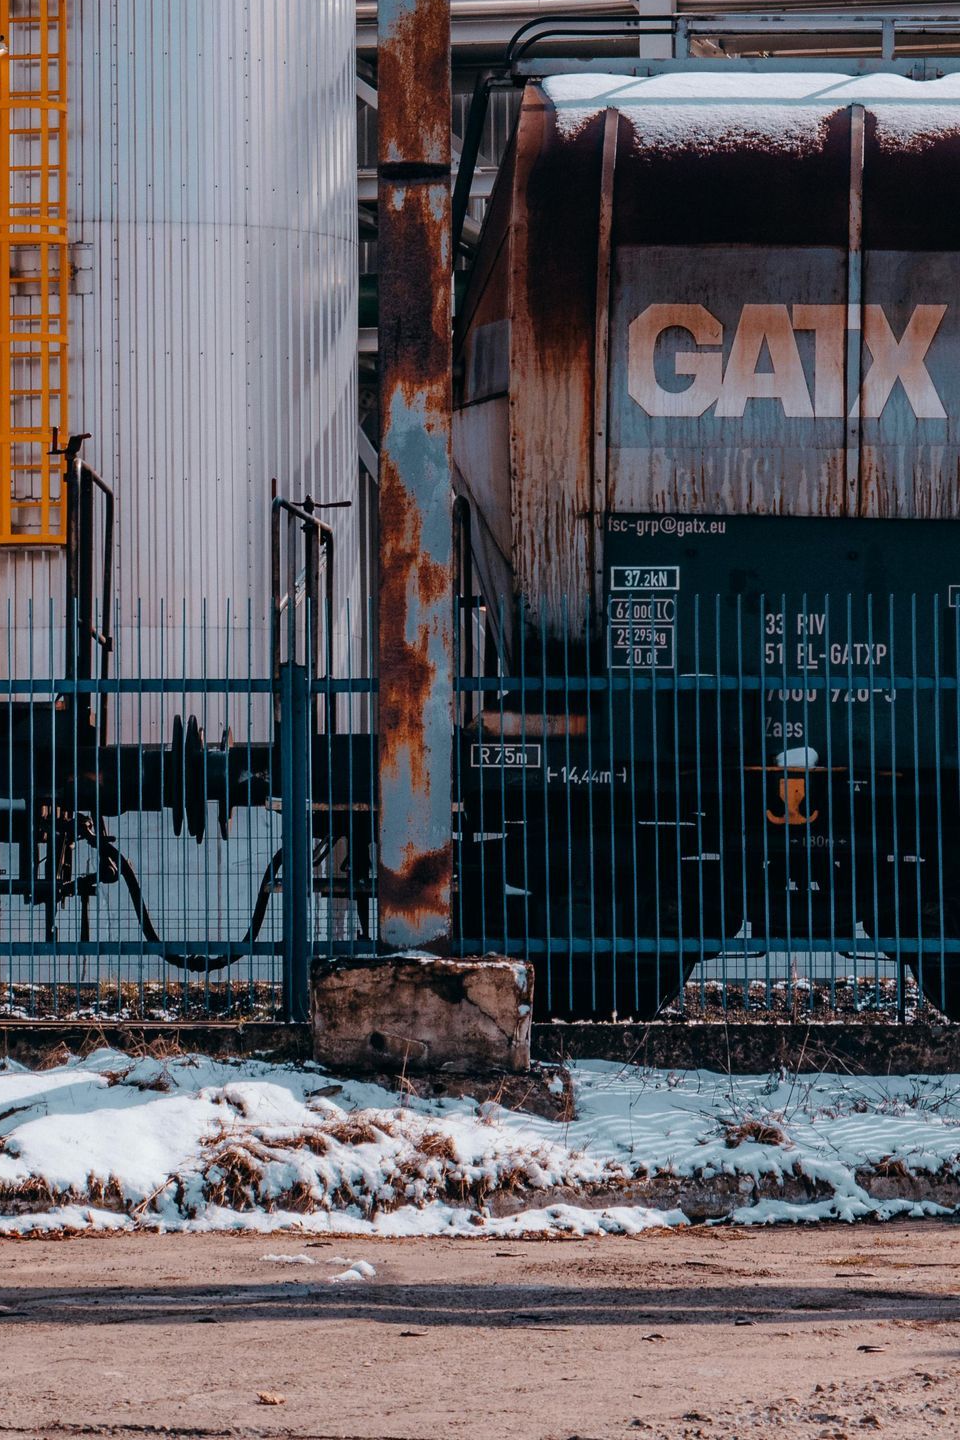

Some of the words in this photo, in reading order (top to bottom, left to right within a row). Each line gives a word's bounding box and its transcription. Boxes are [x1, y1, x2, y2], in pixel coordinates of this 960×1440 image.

[627, 303, 948, 419] GATX
[607, 515, 726, 537] fsc-grp@gatx.eu
[624, 570, 668, 587] 37.2kN
[765, 613, 785, 635] 33
[797, 613, 826, 635] RIV
[765, 643, 784, 665] 51
[765, 716, 804, 738] Zaes
[481, 747, 490, 764] R
[494, 747, 528, 764] 75m
